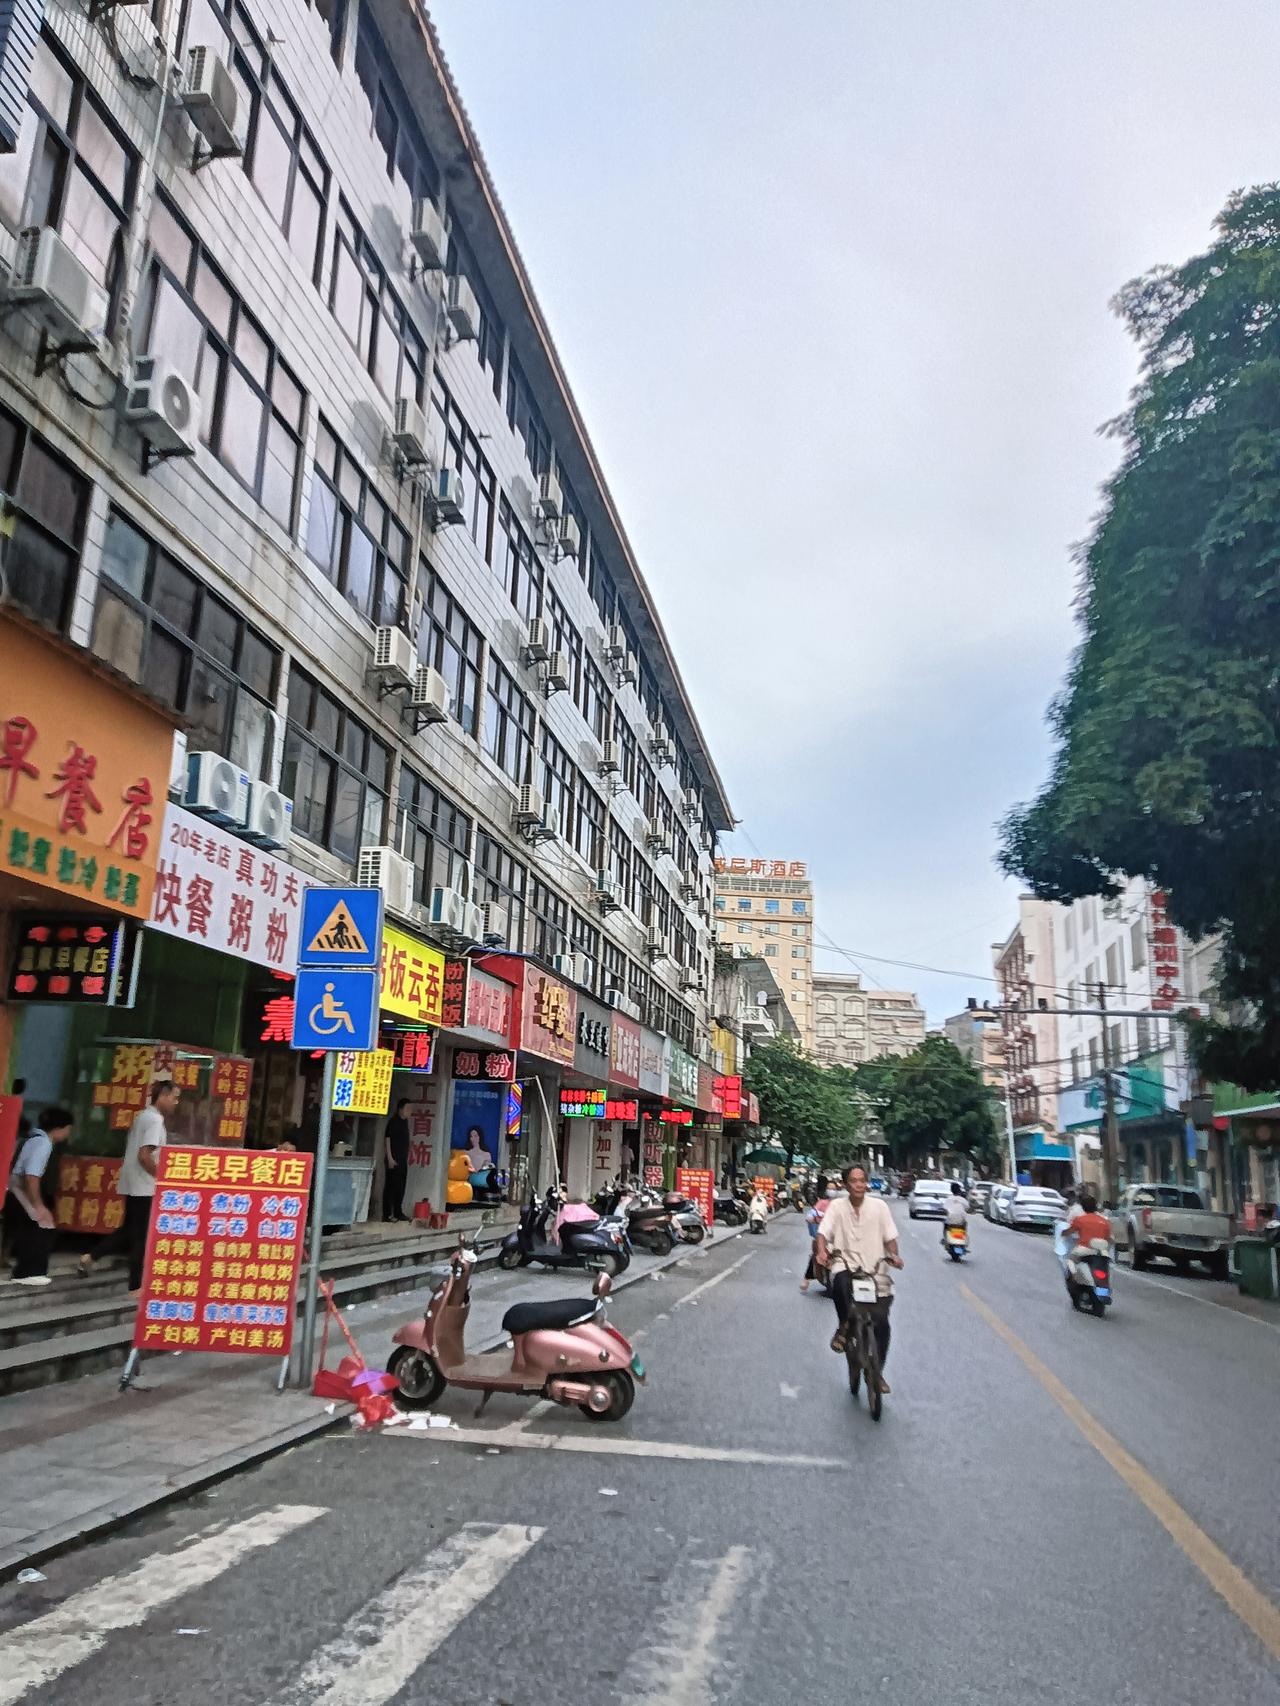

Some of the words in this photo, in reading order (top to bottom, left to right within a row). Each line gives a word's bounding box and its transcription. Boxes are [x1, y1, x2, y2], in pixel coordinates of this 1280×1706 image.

[0, 716, 152, 860] 早餐店
[170, 823, 231, 870] 20年老店
[235, 848, 315, 908] 真功夫
[456, 1052, 511, 1078] 奶粉
[165, 1152, 306, 1185] 温泉早餐店
[208, 1193, 251, 1214] 煮粉
[260, 1195, 302, 1217] 冷粉
[208, 1217, 248, 1237] 云吞
[258, 1219, 297, 1240] 白粥
[150, 1279, 199, 1297] 牛肉粥
[208, 1282, 290, 1302] 皮蛋瘦肉粥
[144, 1324, 200, 1345] 产妇粥
[209, 1328, 284, 1349] 产妇姜汤
